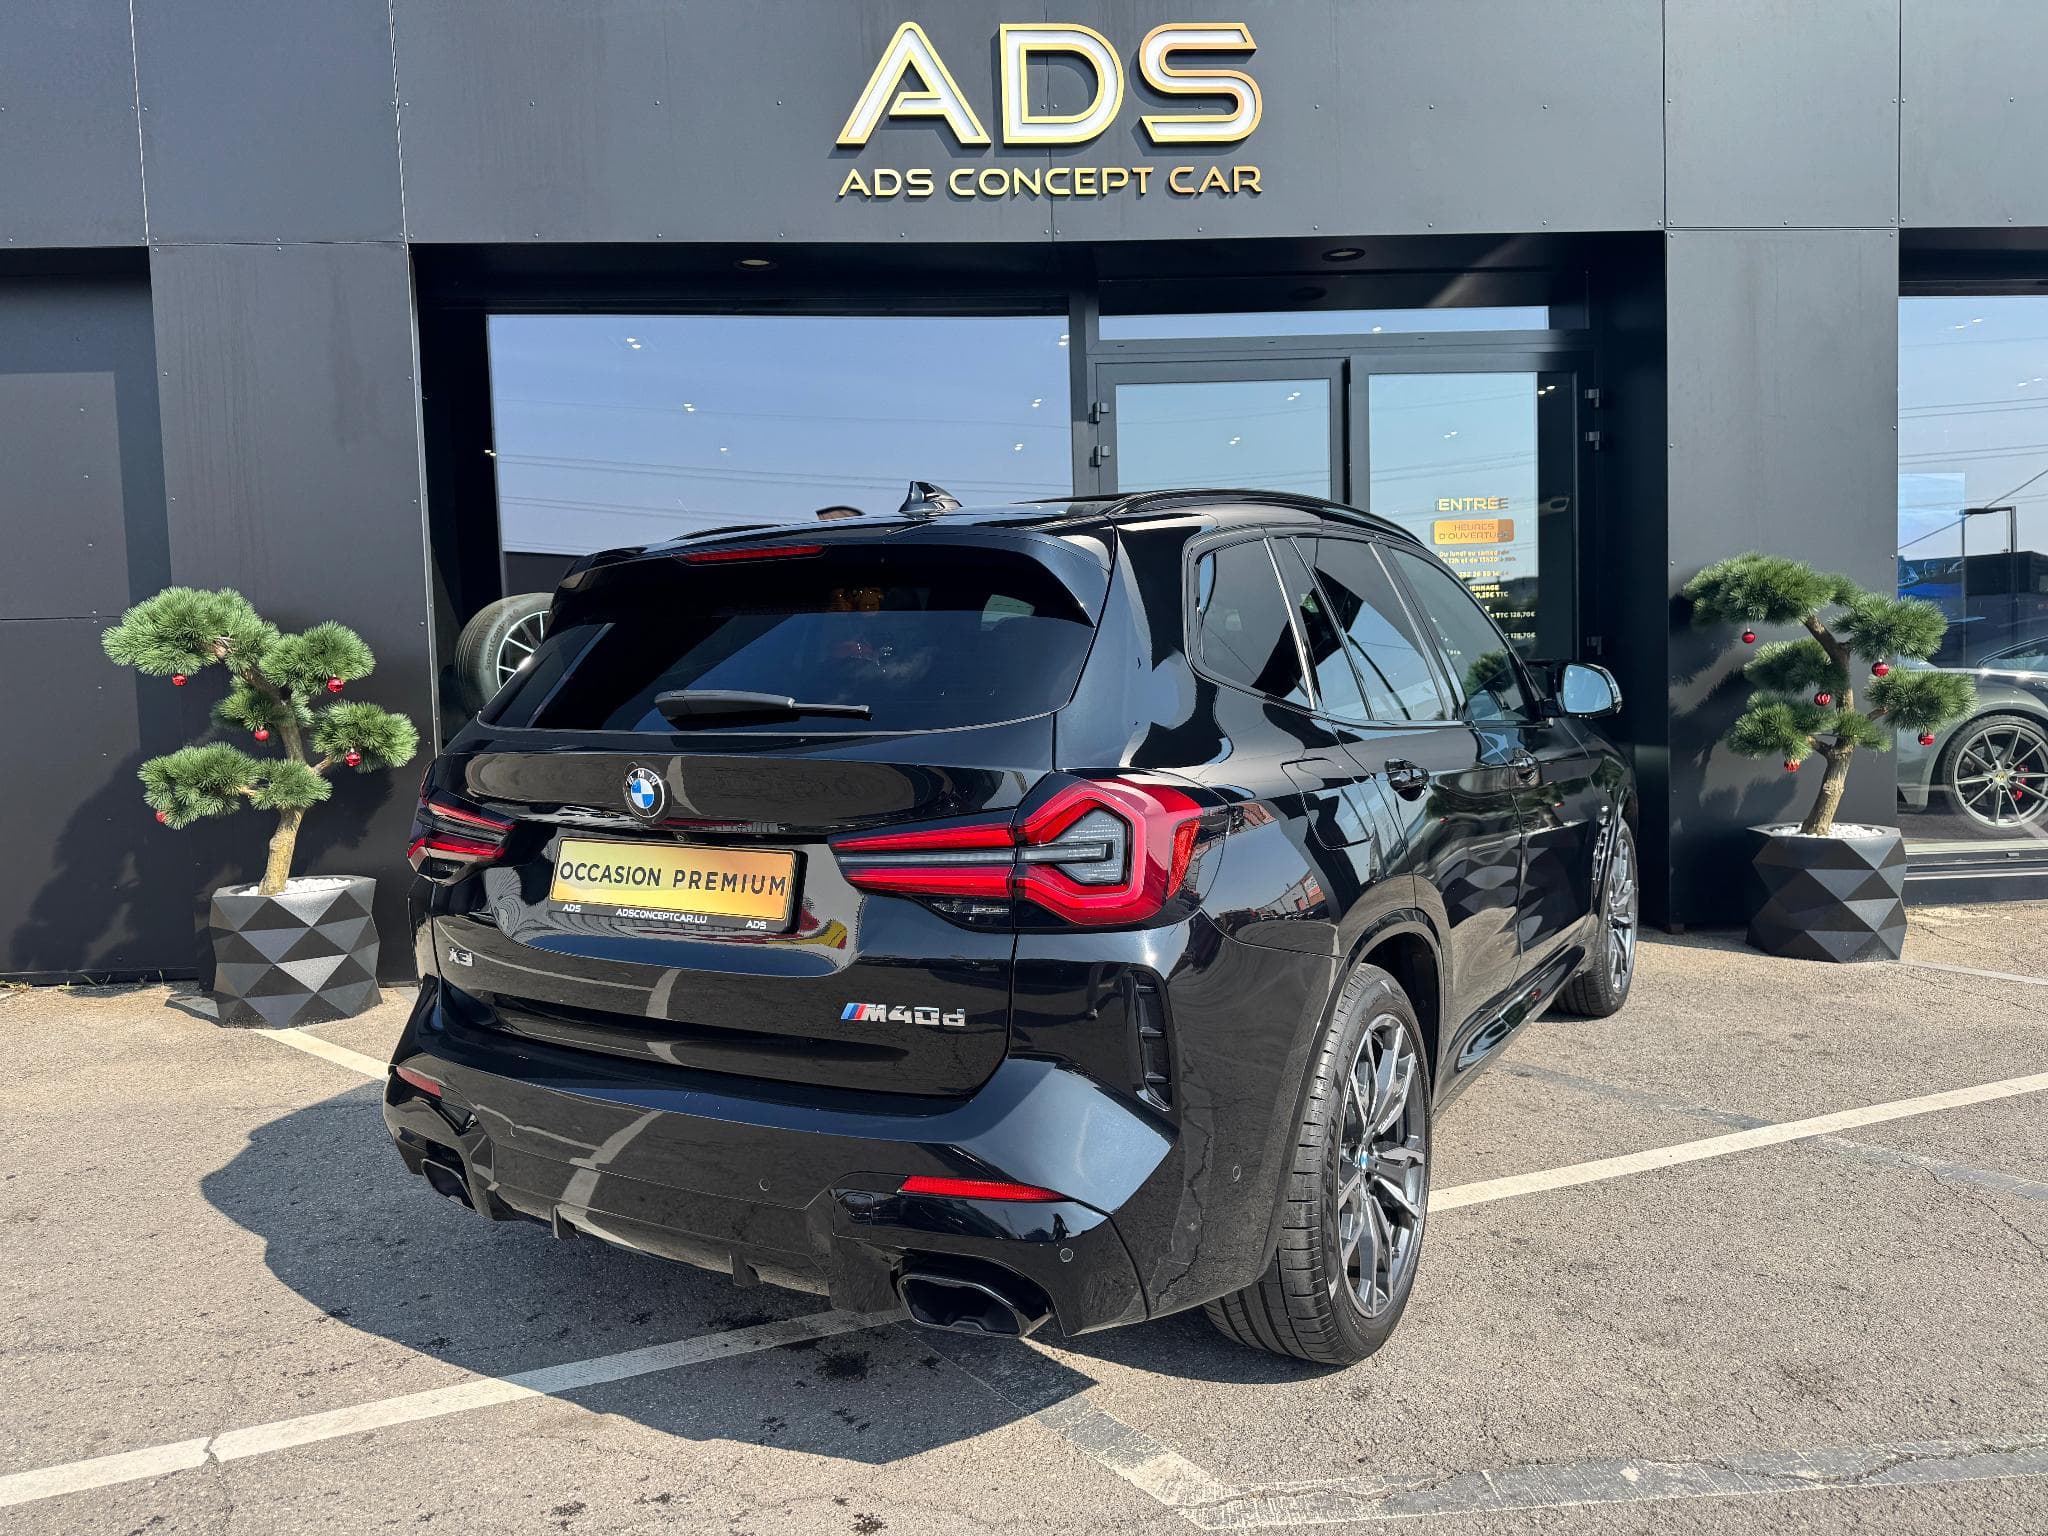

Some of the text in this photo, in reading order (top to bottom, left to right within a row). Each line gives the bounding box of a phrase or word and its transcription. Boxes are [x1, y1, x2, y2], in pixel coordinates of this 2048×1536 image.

[836, 21, 1263, 145] ADS
[838, 166, 1263, 197] ADS CONCEPT CAR
[1455, 523, 1495, 531] HEURES
[560, 861, 787, 896] OCCASION PREMIUM
[562, 903, 582, 913] ADS
[615, 908, 708, 924] ADSCONCEPTCAR.LU
[746, 919, 767, 930] ADS
[858, 1003, 966, 1027] M40d
